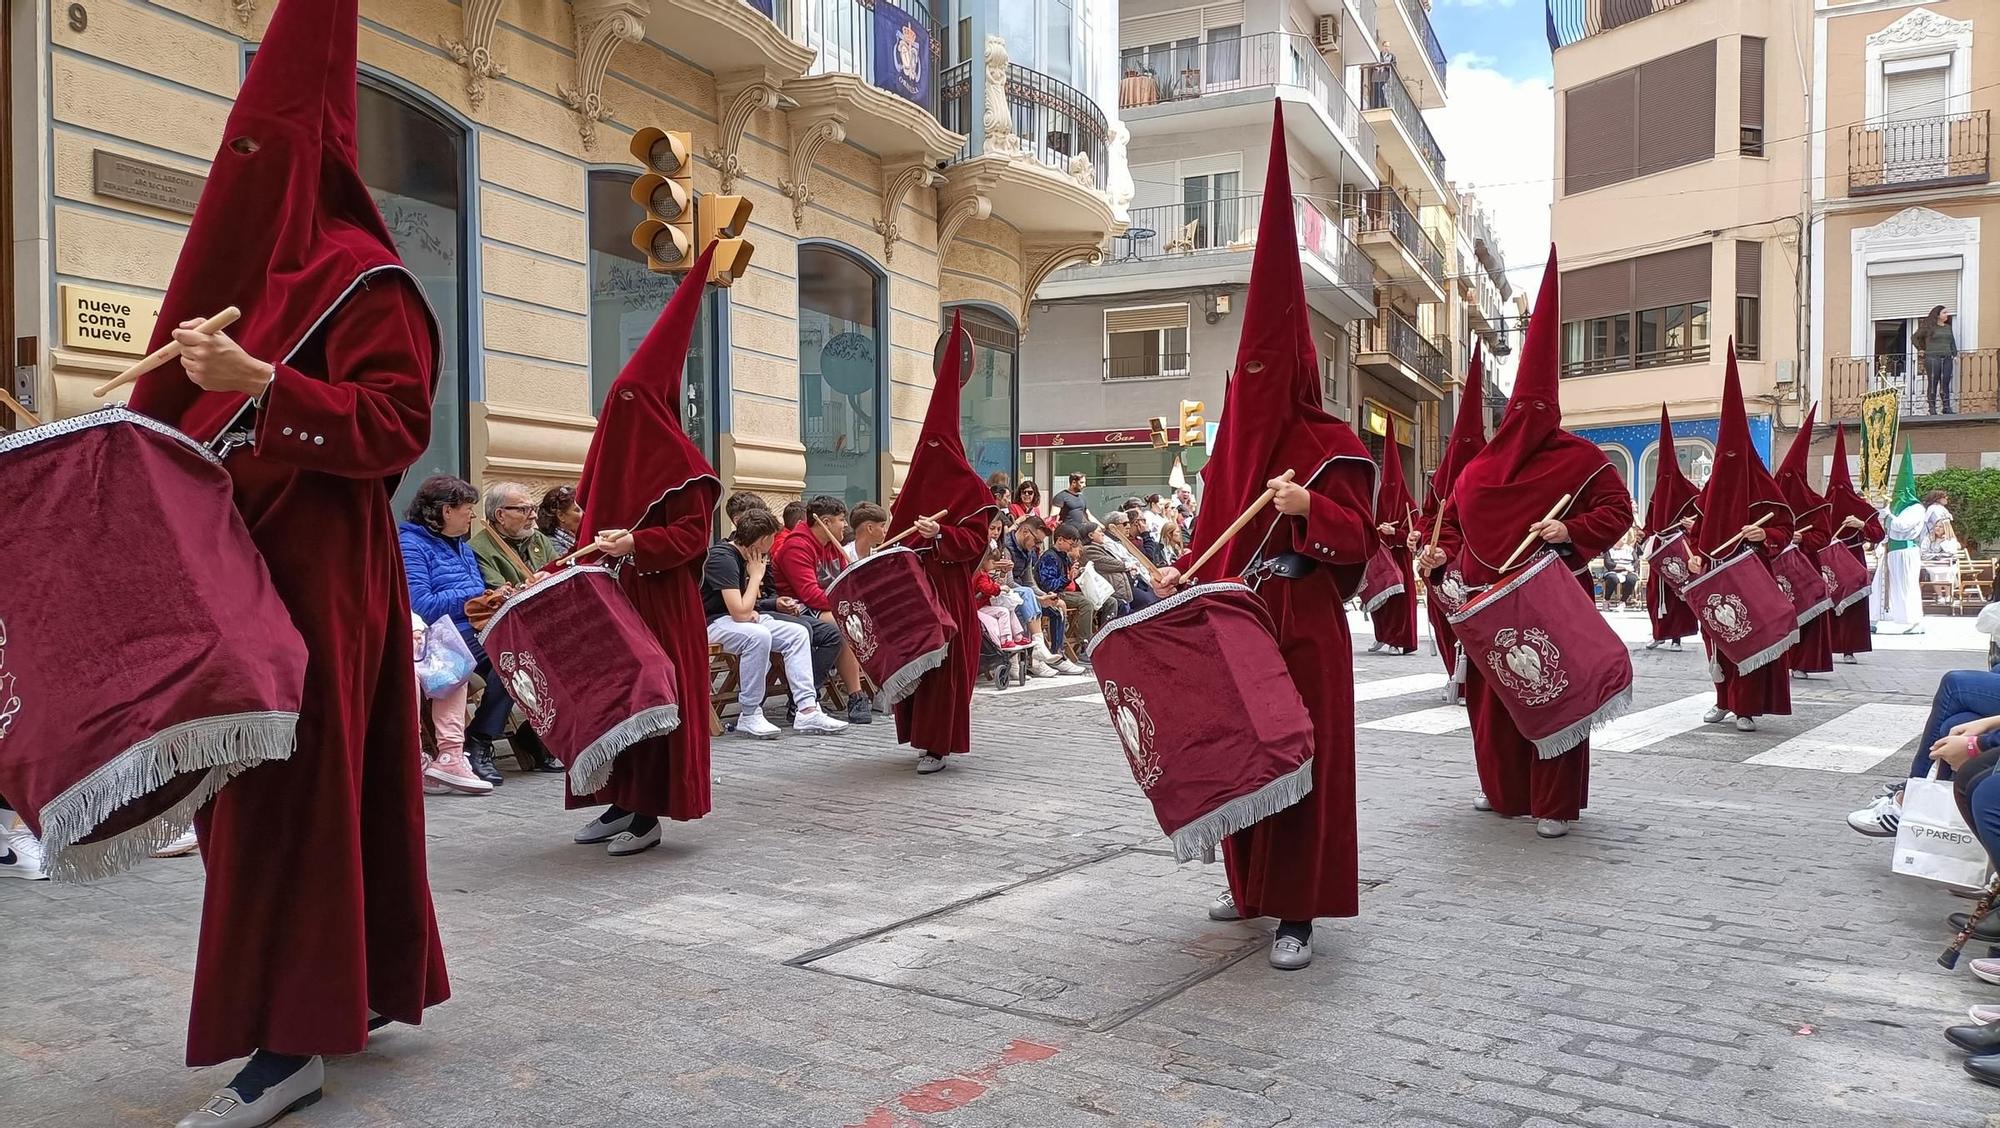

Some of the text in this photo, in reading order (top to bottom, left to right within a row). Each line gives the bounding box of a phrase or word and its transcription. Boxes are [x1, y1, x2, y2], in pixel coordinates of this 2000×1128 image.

[68, 3, 87, 33] 9
[78, 298, 131, 316] nueve
[78, 312, 126, 329] coma
[78, 326, 132, 342] nueve
[1104, 432, 1135, 442] Bar
[1926, 828, 1972, 844] PAREJO
